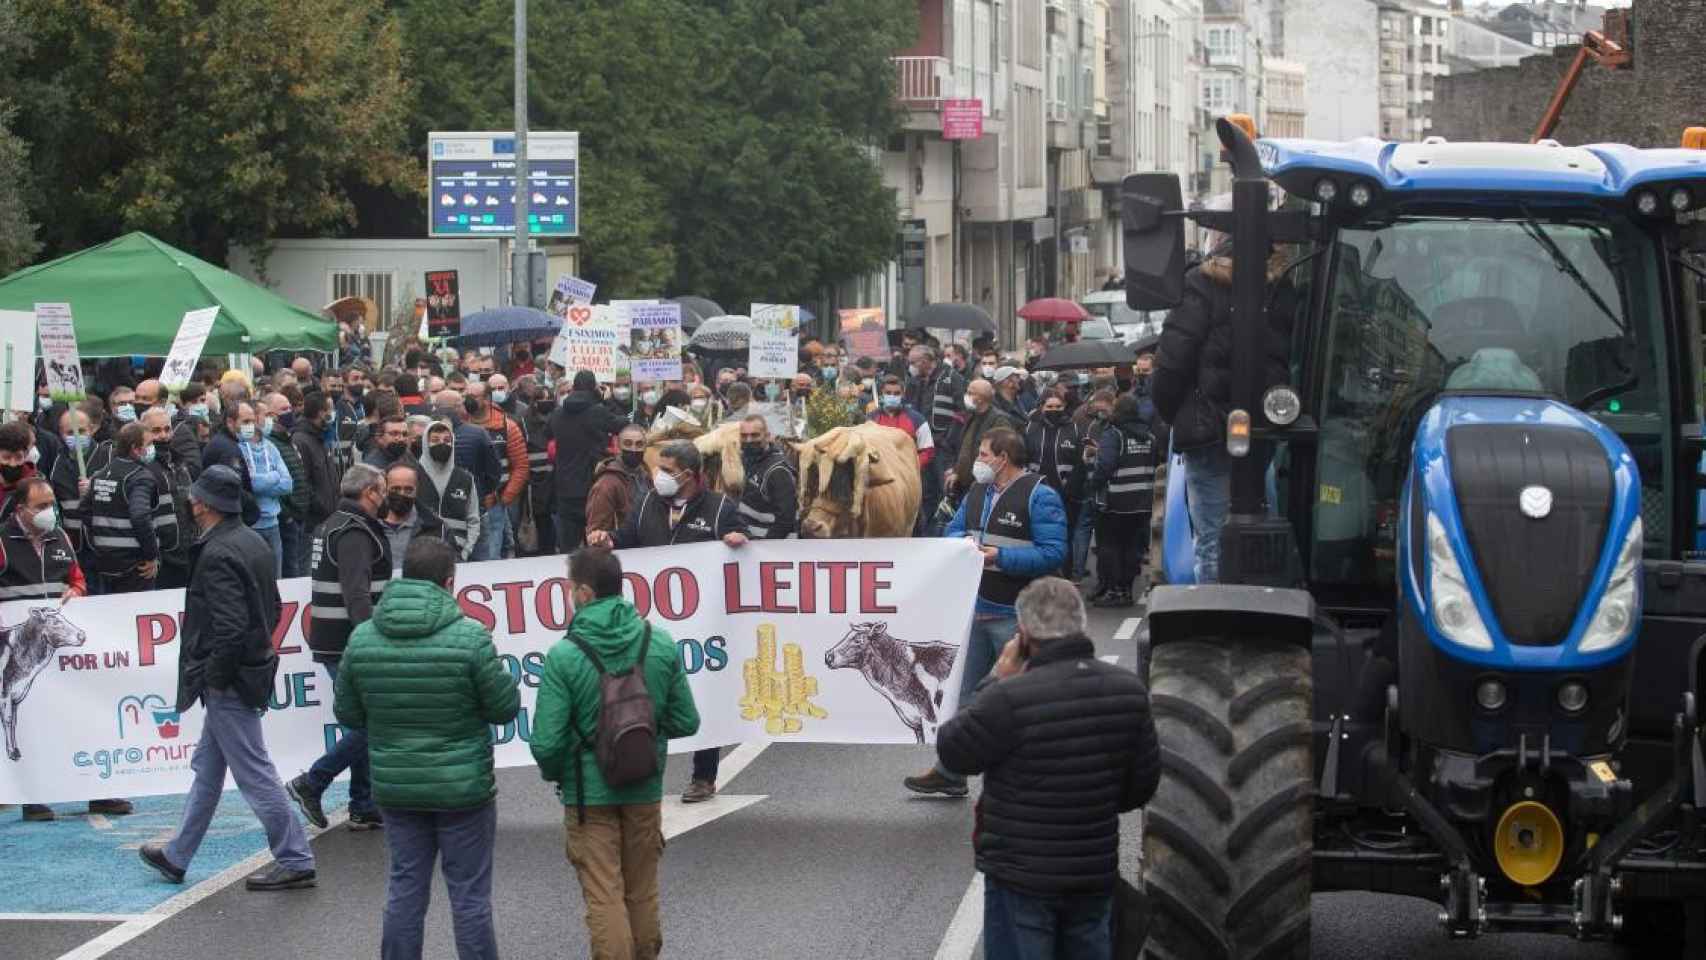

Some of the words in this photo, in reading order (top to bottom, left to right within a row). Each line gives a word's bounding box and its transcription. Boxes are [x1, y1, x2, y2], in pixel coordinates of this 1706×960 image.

[632, 317, 679, 326] PARAMOS
[58, 653, 98, 672] POR
[103, 651, 130, 669] UN
[723, 561, 898, 615] LEITE
[262, 671, 321, 713] UE
